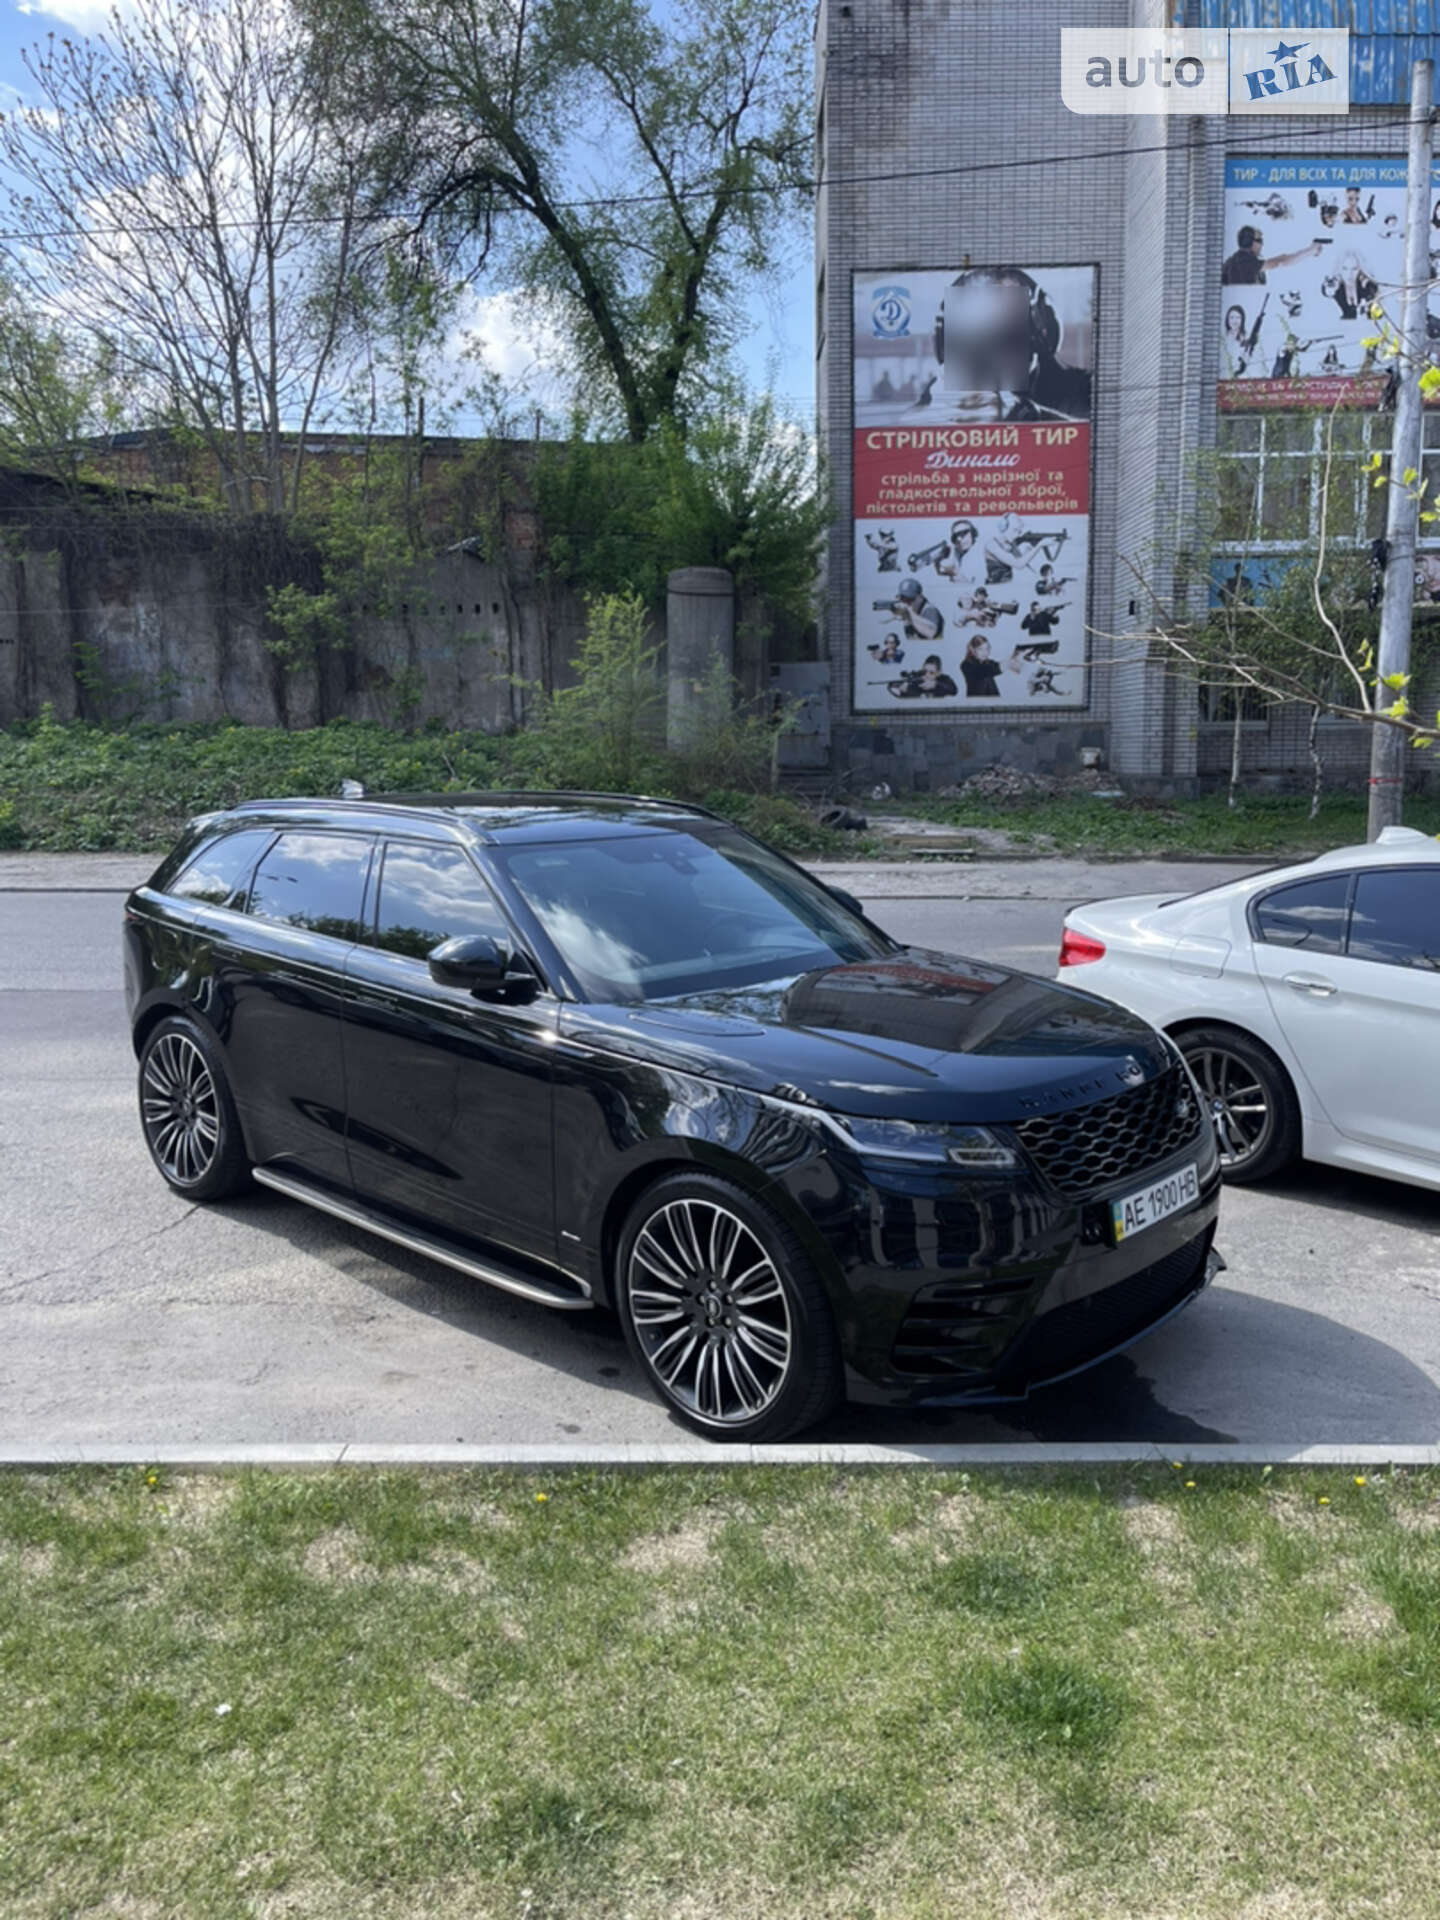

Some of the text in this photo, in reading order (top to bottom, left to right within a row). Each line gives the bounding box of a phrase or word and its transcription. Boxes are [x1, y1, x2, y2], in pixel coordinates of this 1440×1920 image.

[1233, 167, 1258, 181] ТИР
[1268, 167, 1295, 183] ДЛЯ
[1299, 167, 1326, 181] ВСІХ
[1330, 167, 1346, 181] ТА
[1349, 167, 1377, 183] ДЛЯ
[866, 426, 1079, 449] СТРІЛКОВИЙ ТИР
[924, 450, 1021, 469] Динамо
[881, 469, 1064, 487] стрільба з нарізної та
[878, 483, 1067, 500] гладкоствольної зброї,
[866, 498, 1078, 515] пістолетів та револьверів
[1125, 1196, 1146, 1231] AE
[1148, 1180, 1178, 1217] 1900
[1178, 1170, 1196, 1202] HB
